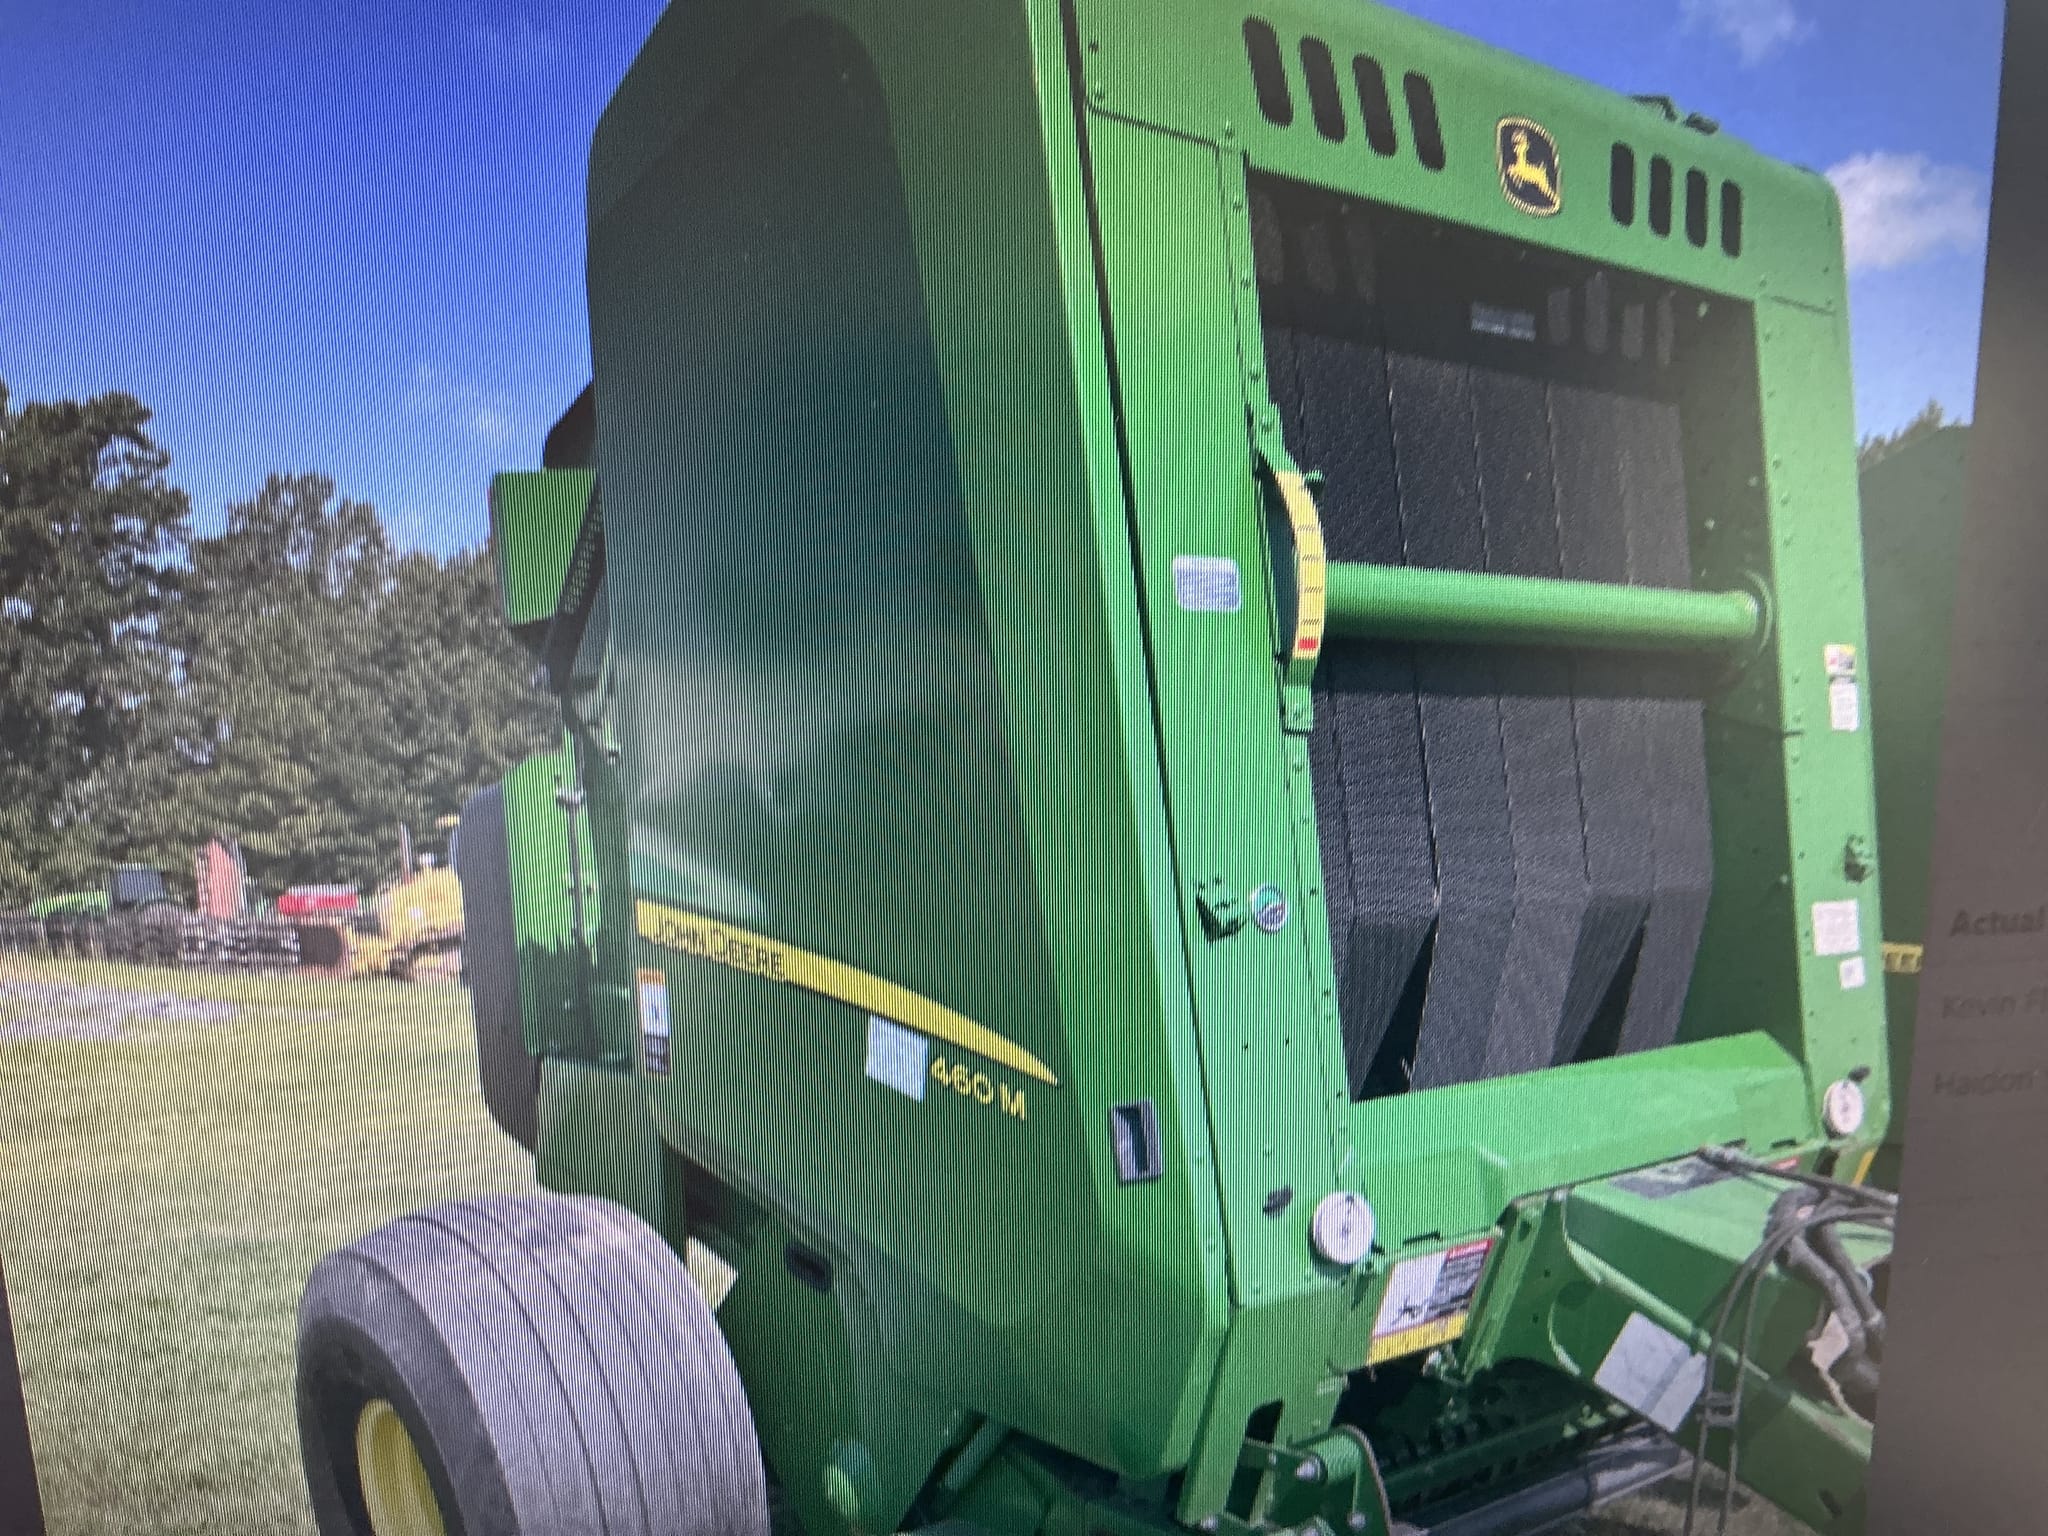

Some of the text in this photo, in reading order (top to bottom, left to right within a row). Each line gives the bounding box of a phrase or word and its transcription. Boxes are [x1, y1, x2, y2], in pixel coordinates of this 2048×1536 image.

[654, 914, 785, 978] JOHN DEERE
[1949, 906, 2046, 936] Actual
[930, 1055, 994, 1104] 460
[1000, 1081, 1027, 1121] M
